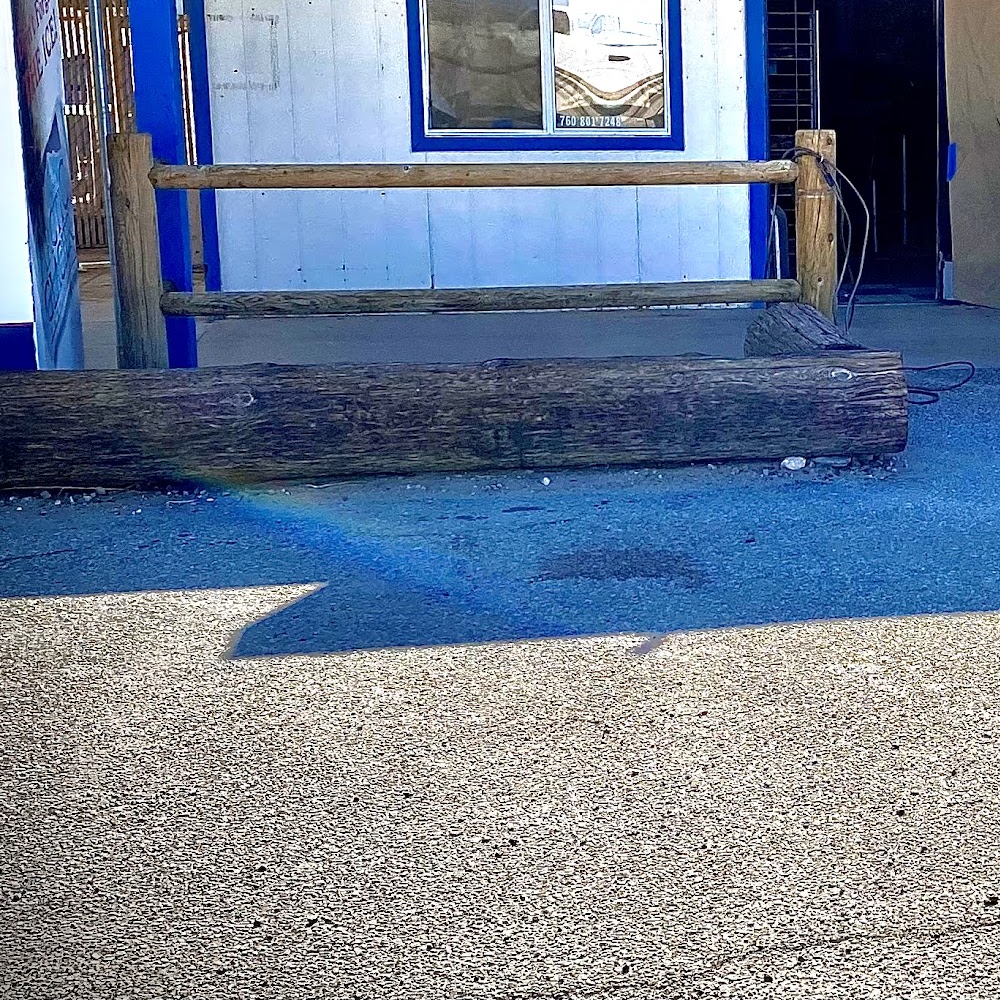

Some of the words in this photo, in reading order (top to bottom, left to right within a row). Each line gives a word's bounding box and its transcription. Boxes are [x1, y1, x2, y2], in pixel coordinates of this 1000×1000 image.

[560, 116, 576, 127] 760
[580, 116, 595, 127] 801
[600, 116, 621, 127] 7248
